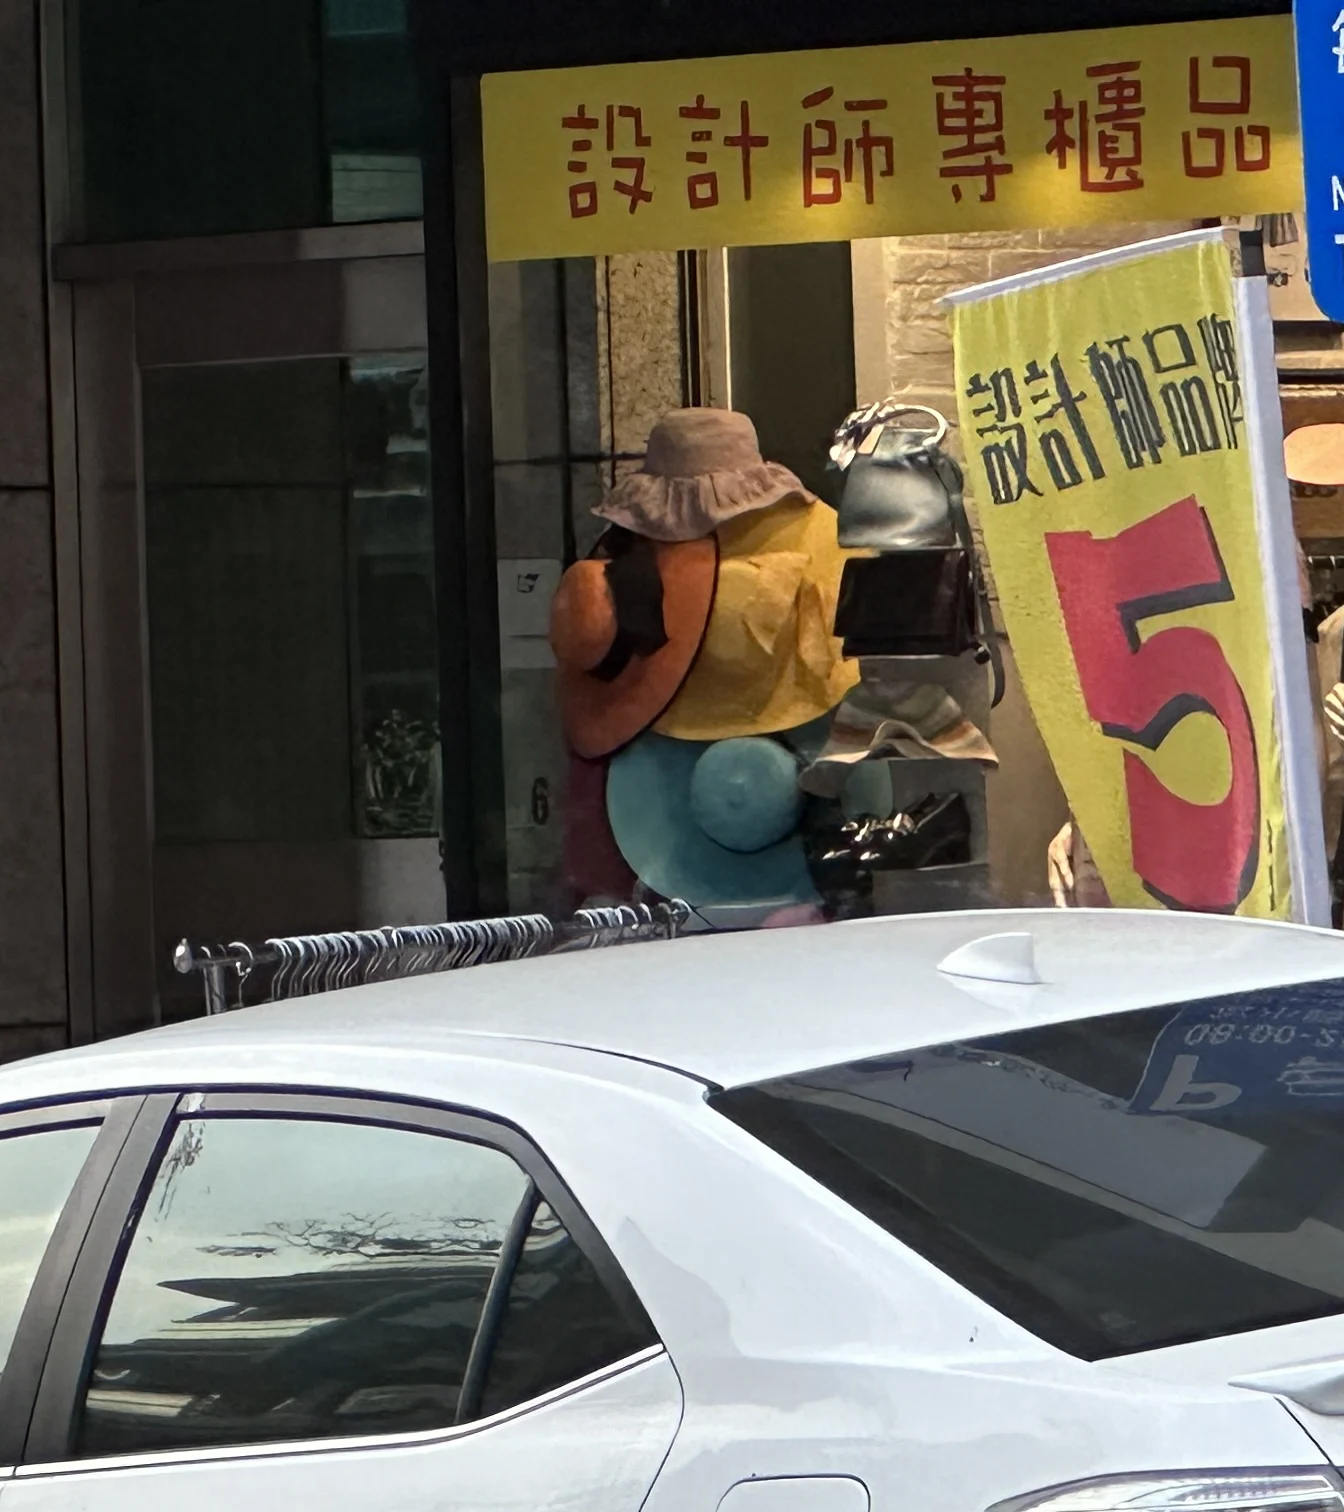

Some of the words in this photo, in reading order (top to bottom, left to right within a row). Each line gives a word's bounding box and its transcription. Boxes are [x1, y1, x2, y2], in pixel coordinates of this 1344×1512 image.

[561, 56, 1272, 218] 設計師專櫃品
[1044, 493, 1262, 914] 5
